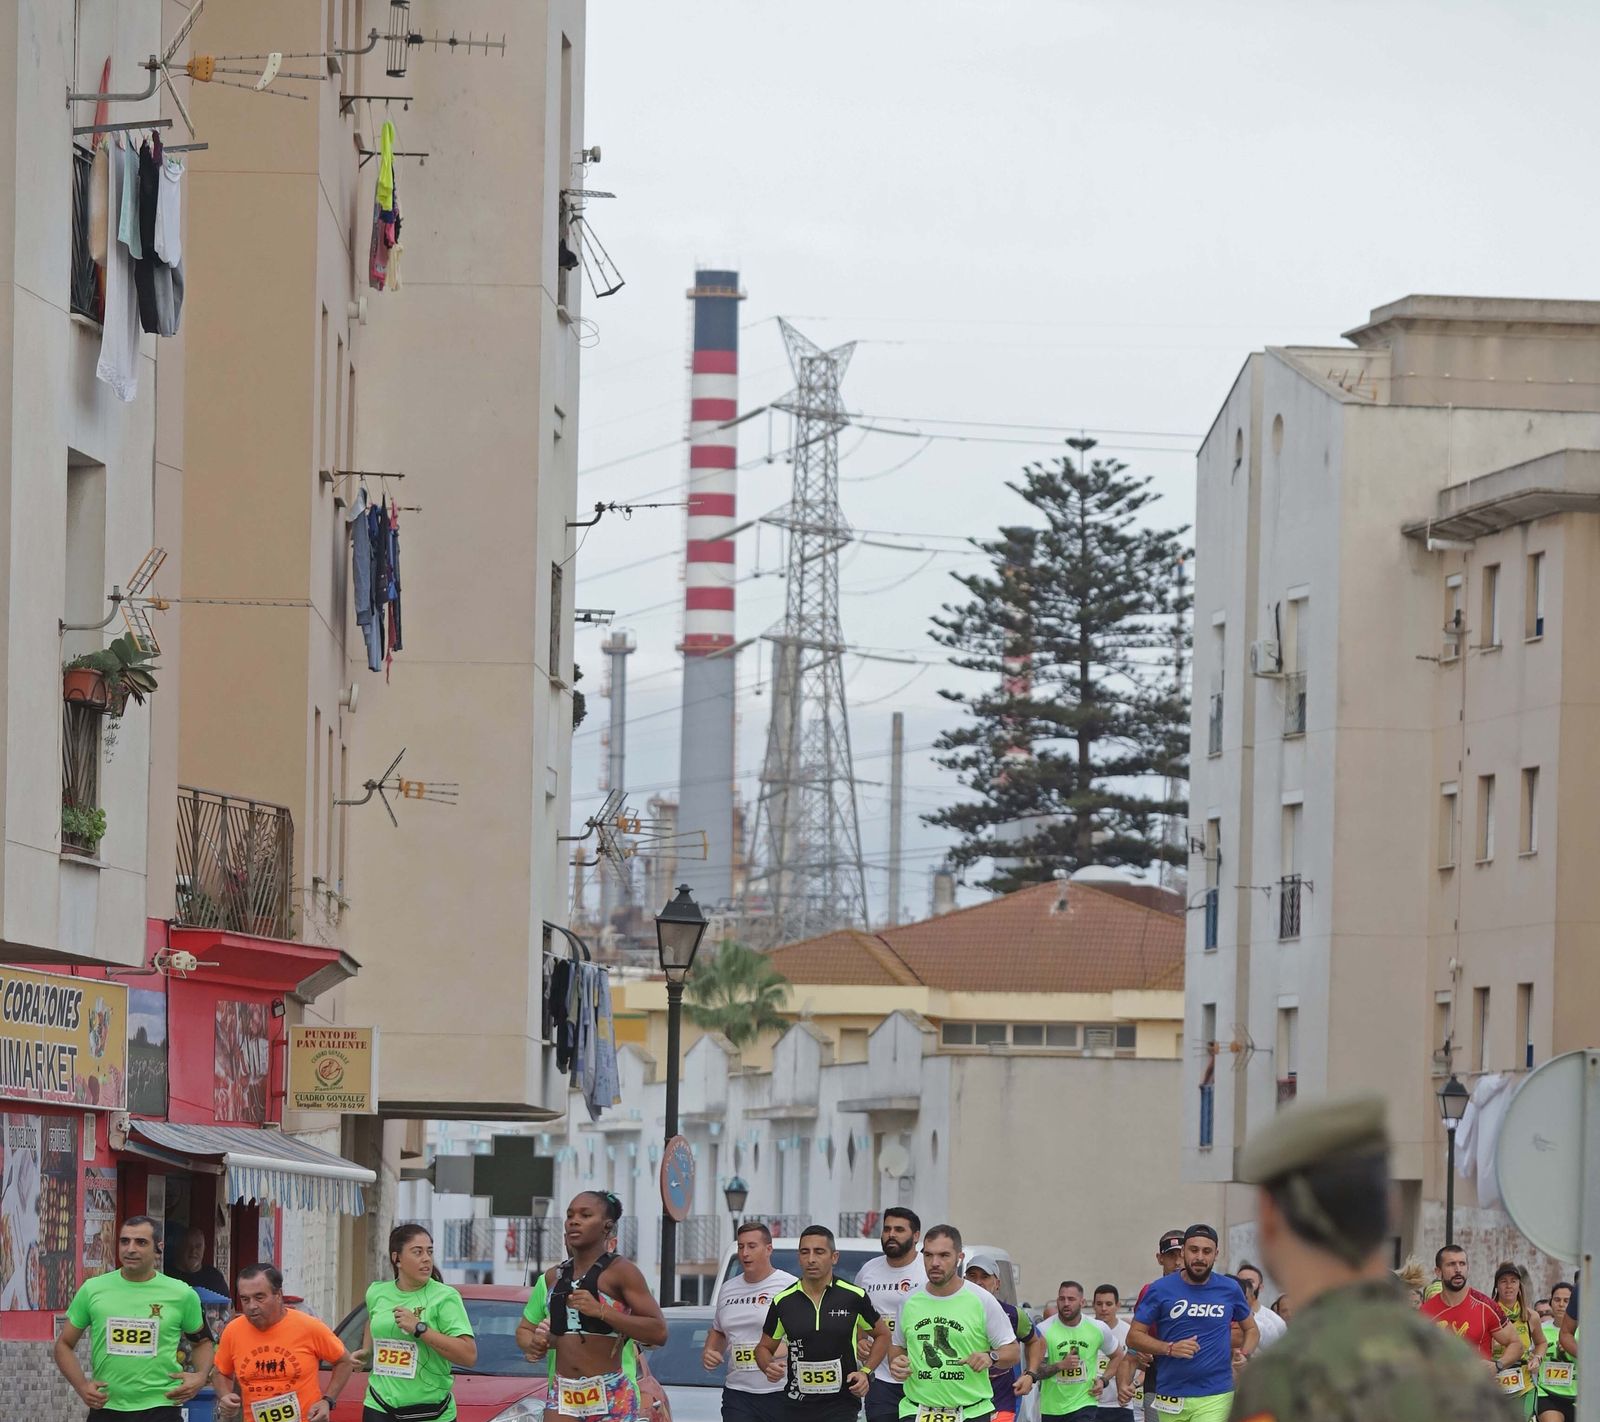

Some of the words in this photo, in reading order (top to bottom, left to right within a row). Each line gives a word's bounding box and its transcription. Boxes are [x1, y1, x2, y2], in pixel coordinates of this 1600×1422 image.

[3, 980, 83, 1030] CORAZONES
[305, 1030, 340, 1039] PUNTO
[344, 1031, 357, 1040] DE
[297, 1039, 316, 1048] PAN
[319, 1041, 367, 1049] CALIENTE
[0, 1038, 77, 1093] IMARKET
[295, 1094, 325, 1102] CUADRO
[326, 1094, 365, 1103] GONZALEZ
[112, 1328, 152, 1344] 382
[378, 1349, 412, 1366] 352
[803, 1370, 837, 1384] 353
[1546, 1368, 1569, 1379] 172
[563, 1387, 600, 1405] 304
